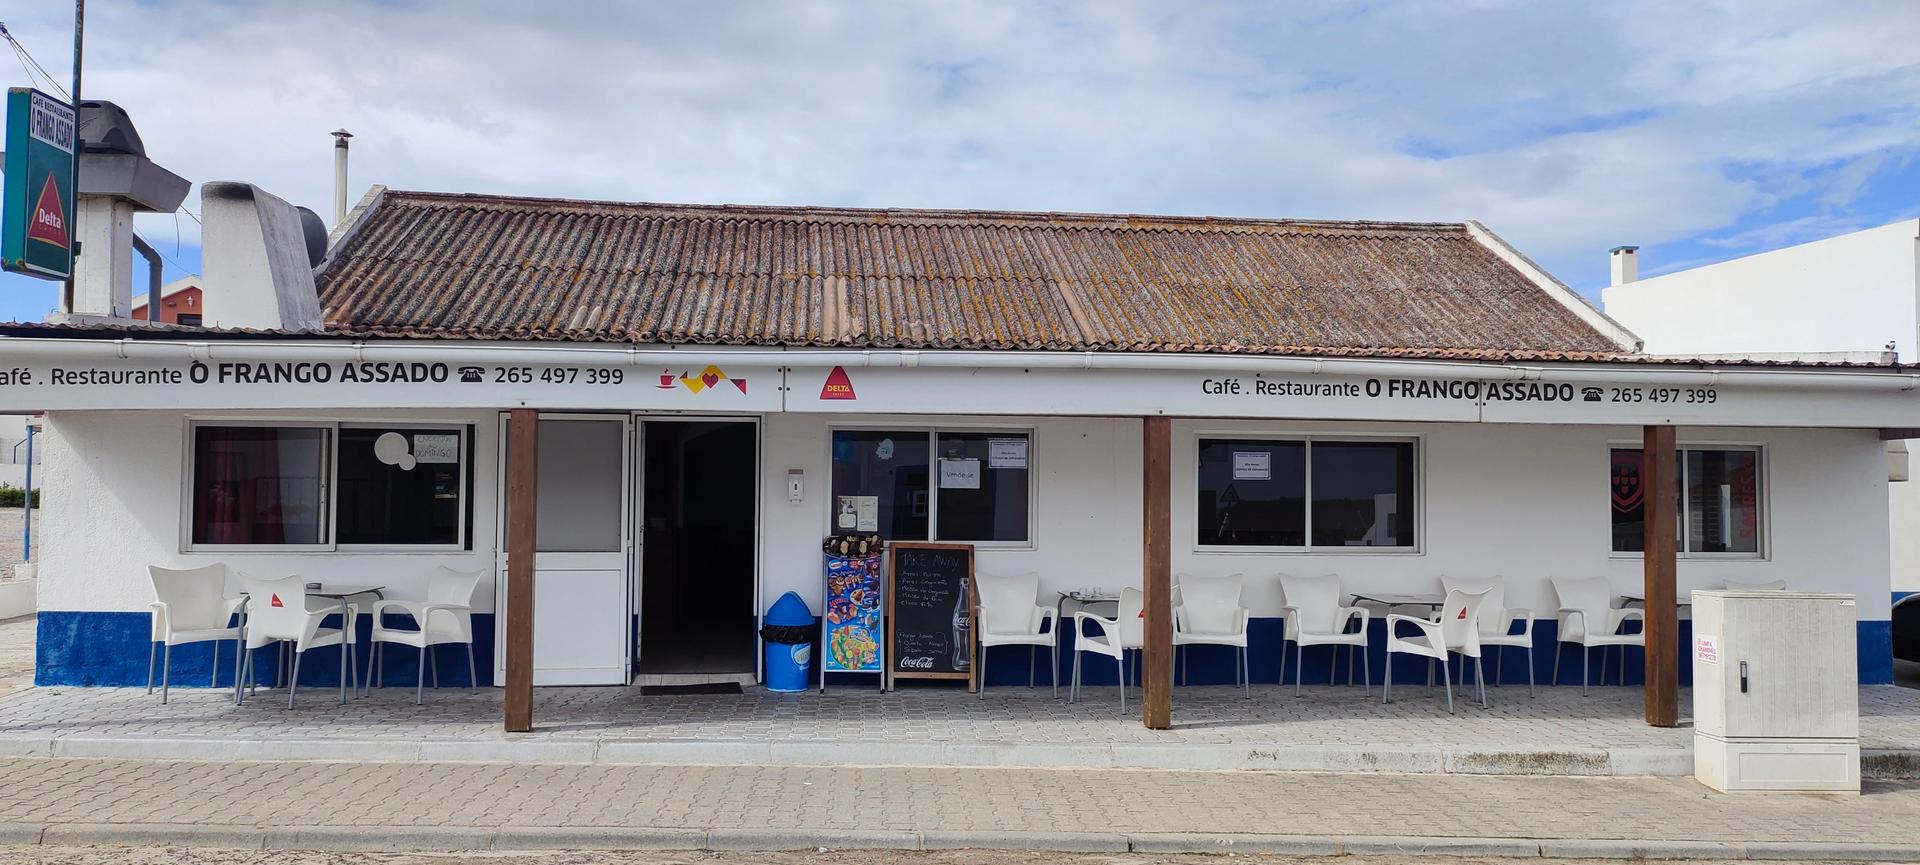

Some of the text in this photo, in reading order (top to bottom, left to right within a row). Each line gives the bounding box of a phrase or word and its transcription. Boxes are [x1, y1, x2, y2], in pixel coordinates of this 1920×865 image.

[45, 101, 74, 122] RESTAURANTE
[32, 107, 73, 150] O FRANGO ASSADO
[39, 208, 62, 229] Delta
[51, 367, 182, 385] Restaurante
[189, 362, 209, 384] O
[218, 362, 332, 384] FRANGO
[339, 362, 449, 383] ASSADO
[494, 367, 533, 383] 265
[540, 367, 579, 384] 497
[585, 368, 624, 384] 399
[1202, 378, 1241, 395] Café
[1256, 379, 1360, 397] Restaurante
[1365, 378, 1381, 397] O
[1388, 379, 1479, 400] FRANGO
[1485, 382, 1574, 401] ASSADO
[1611, 388, 1643, 403] 265
[1648, 388, 1680, 403] 497
[1685, 388, 1717, 404] 399
[416, 449, 451, 458] DOMINGO
